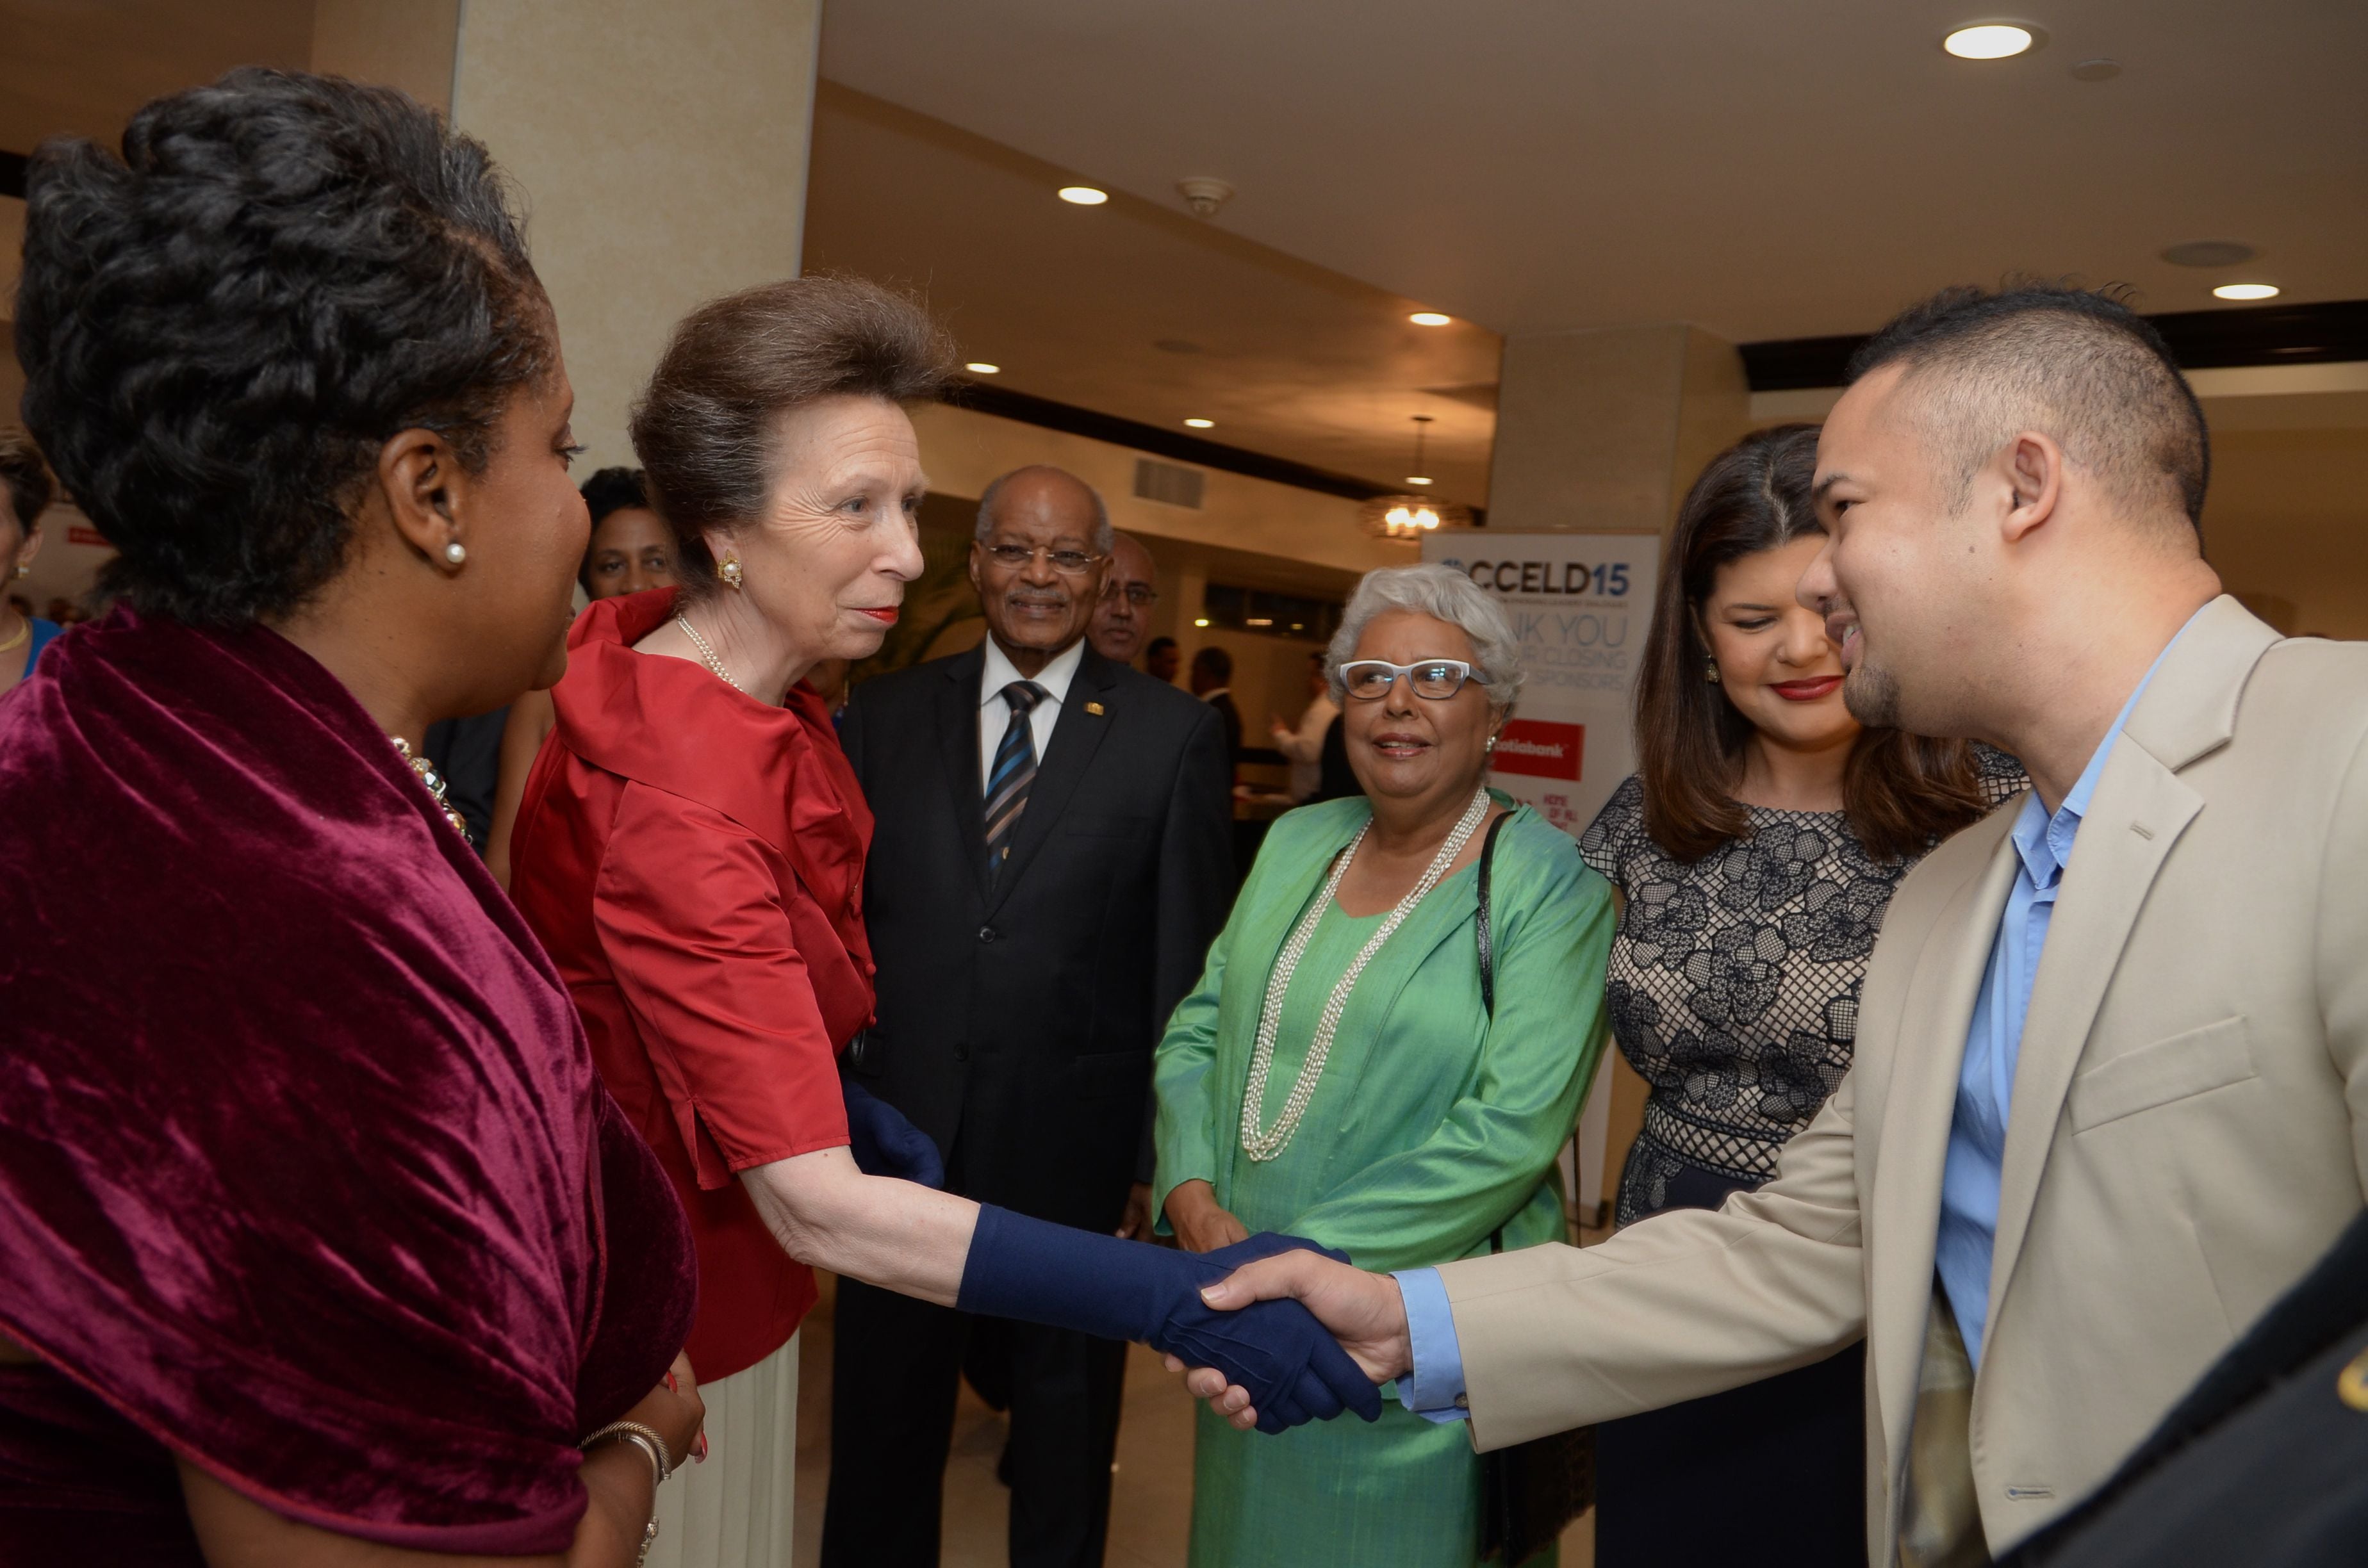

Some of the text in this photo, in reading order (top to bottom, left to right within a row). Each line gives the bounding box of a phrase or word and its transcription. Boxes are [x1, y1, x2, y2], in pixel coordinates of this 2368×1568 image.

[1468, 560, 1631, 596] CCELD15
[1556, 612, 1628, 648] YOU
[1495, 739, 1563, 758] cotiabank
